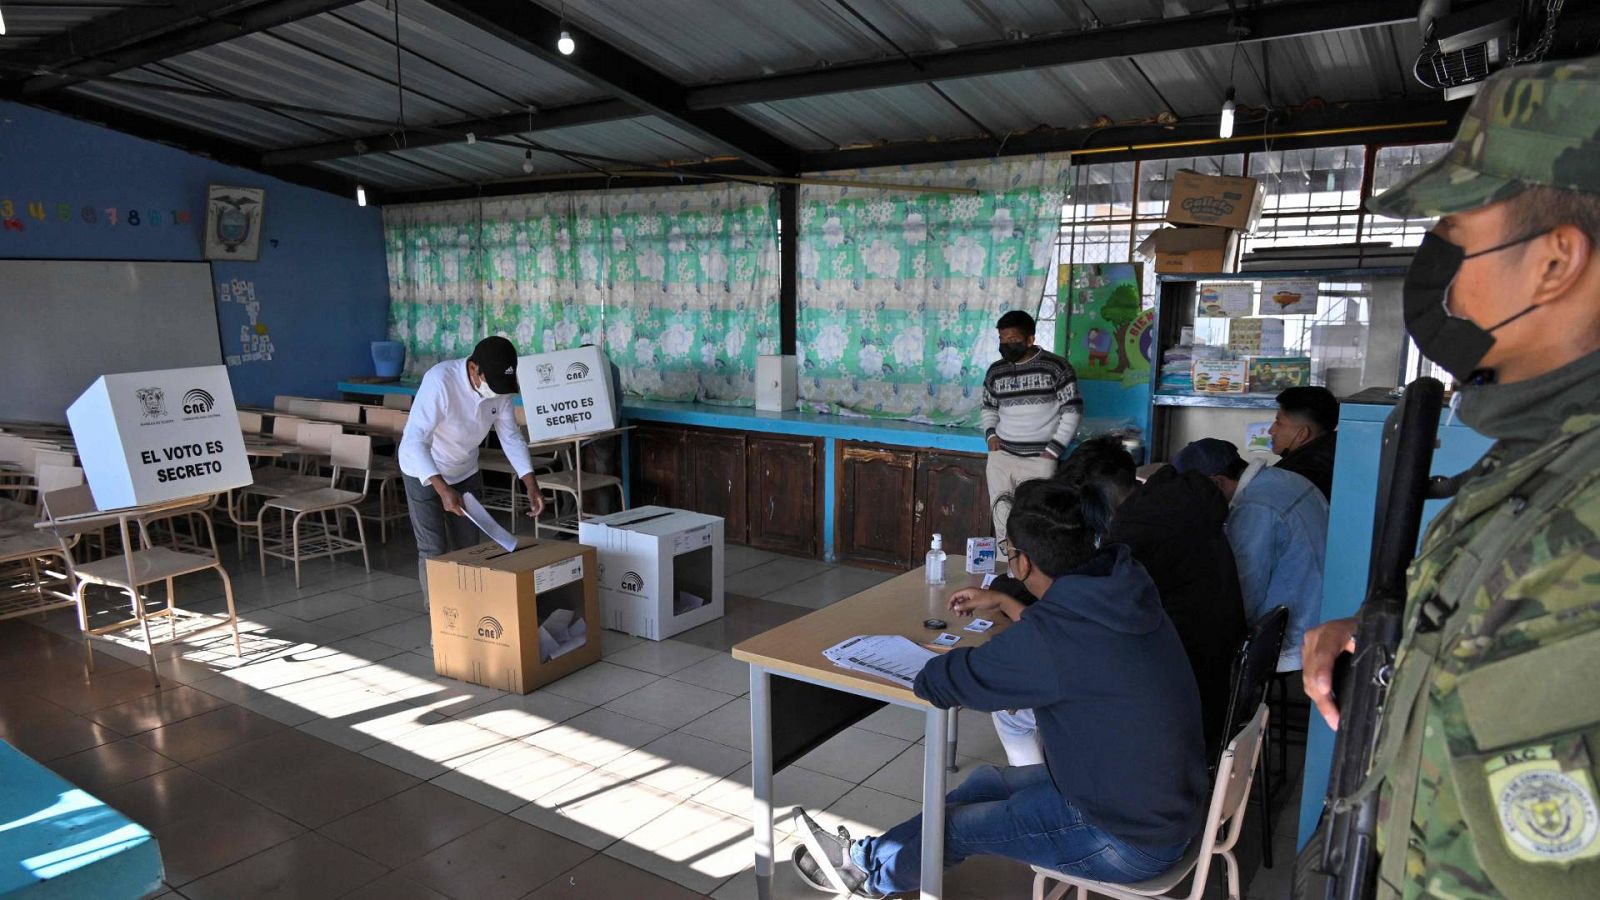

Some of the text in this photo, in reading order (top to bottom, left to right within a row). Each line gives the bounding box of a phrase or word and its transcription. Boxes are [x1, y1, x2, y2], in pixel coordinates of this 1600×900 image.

[128, 209, 141, 226] 8
[536, 397, 594, 415] EL VOTO ES
[546, 411, 592, 426] SECRETO
[141, 440, 224, 465] EL VOTO ES
[157, 460, 222, 483] SECRETO
